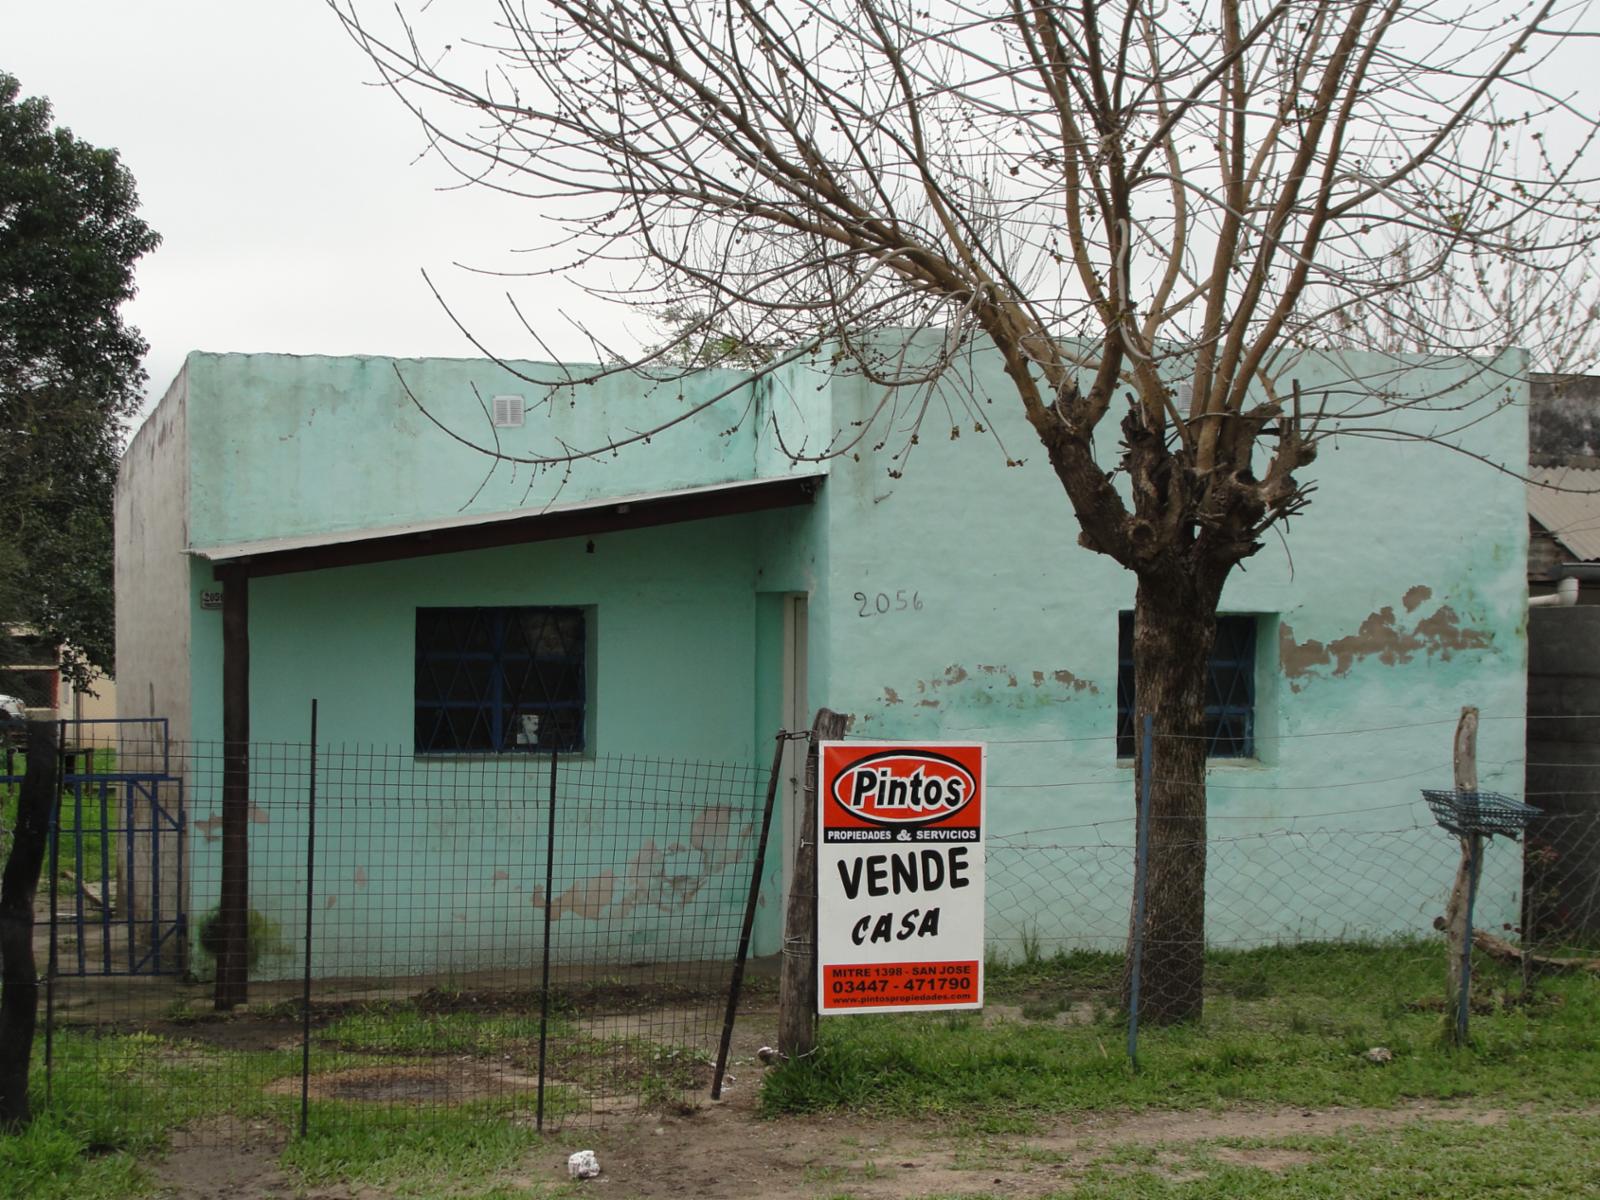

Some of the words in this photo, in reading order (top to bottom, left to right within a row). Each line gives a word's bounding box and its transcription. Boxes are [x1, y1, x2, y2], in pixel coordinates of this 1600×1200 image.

[853, 590, 923, 617] 2056
[851, 765, 965, 811] Pintos
[828, 831, 892, 840] PROPIEDADES
[896, 829, 912, 841] &
[916, 830, 977, 839] SERVICIOS
[837, 846, 970, 900] VENDE
[851, 907, 941, 946] CASA
[832, 968, 871, 977] MITRE
[876, 967, 903, 977] 1398
[912, 966, 937, 976] SAN
[940, 966, 971, 975] JOSE
[832, 980, 889, 994] 03447
[904, 977, 971, 991] 471790
[832, 994, 971, 1004] www.pintospropiedades.com
